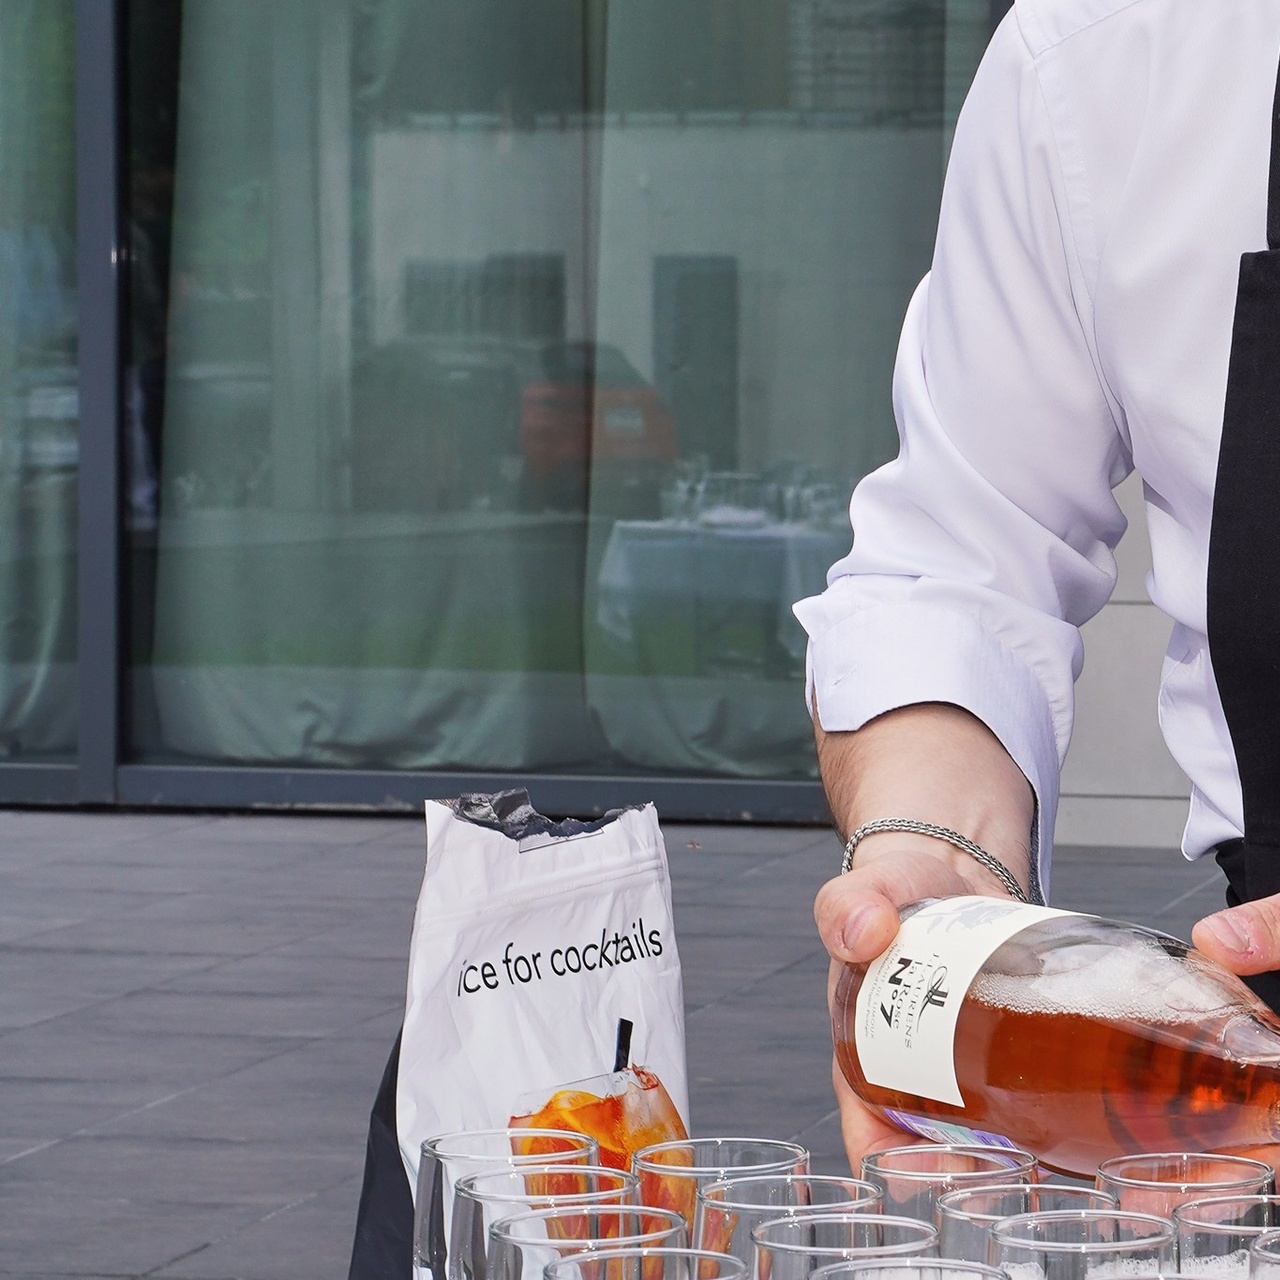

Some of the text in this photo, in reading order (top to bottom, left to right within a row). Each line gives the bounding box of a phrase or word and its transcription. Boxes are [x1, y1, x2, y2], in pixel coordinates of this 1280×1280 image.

[457, 917, 663, 997] ice for cocktails
